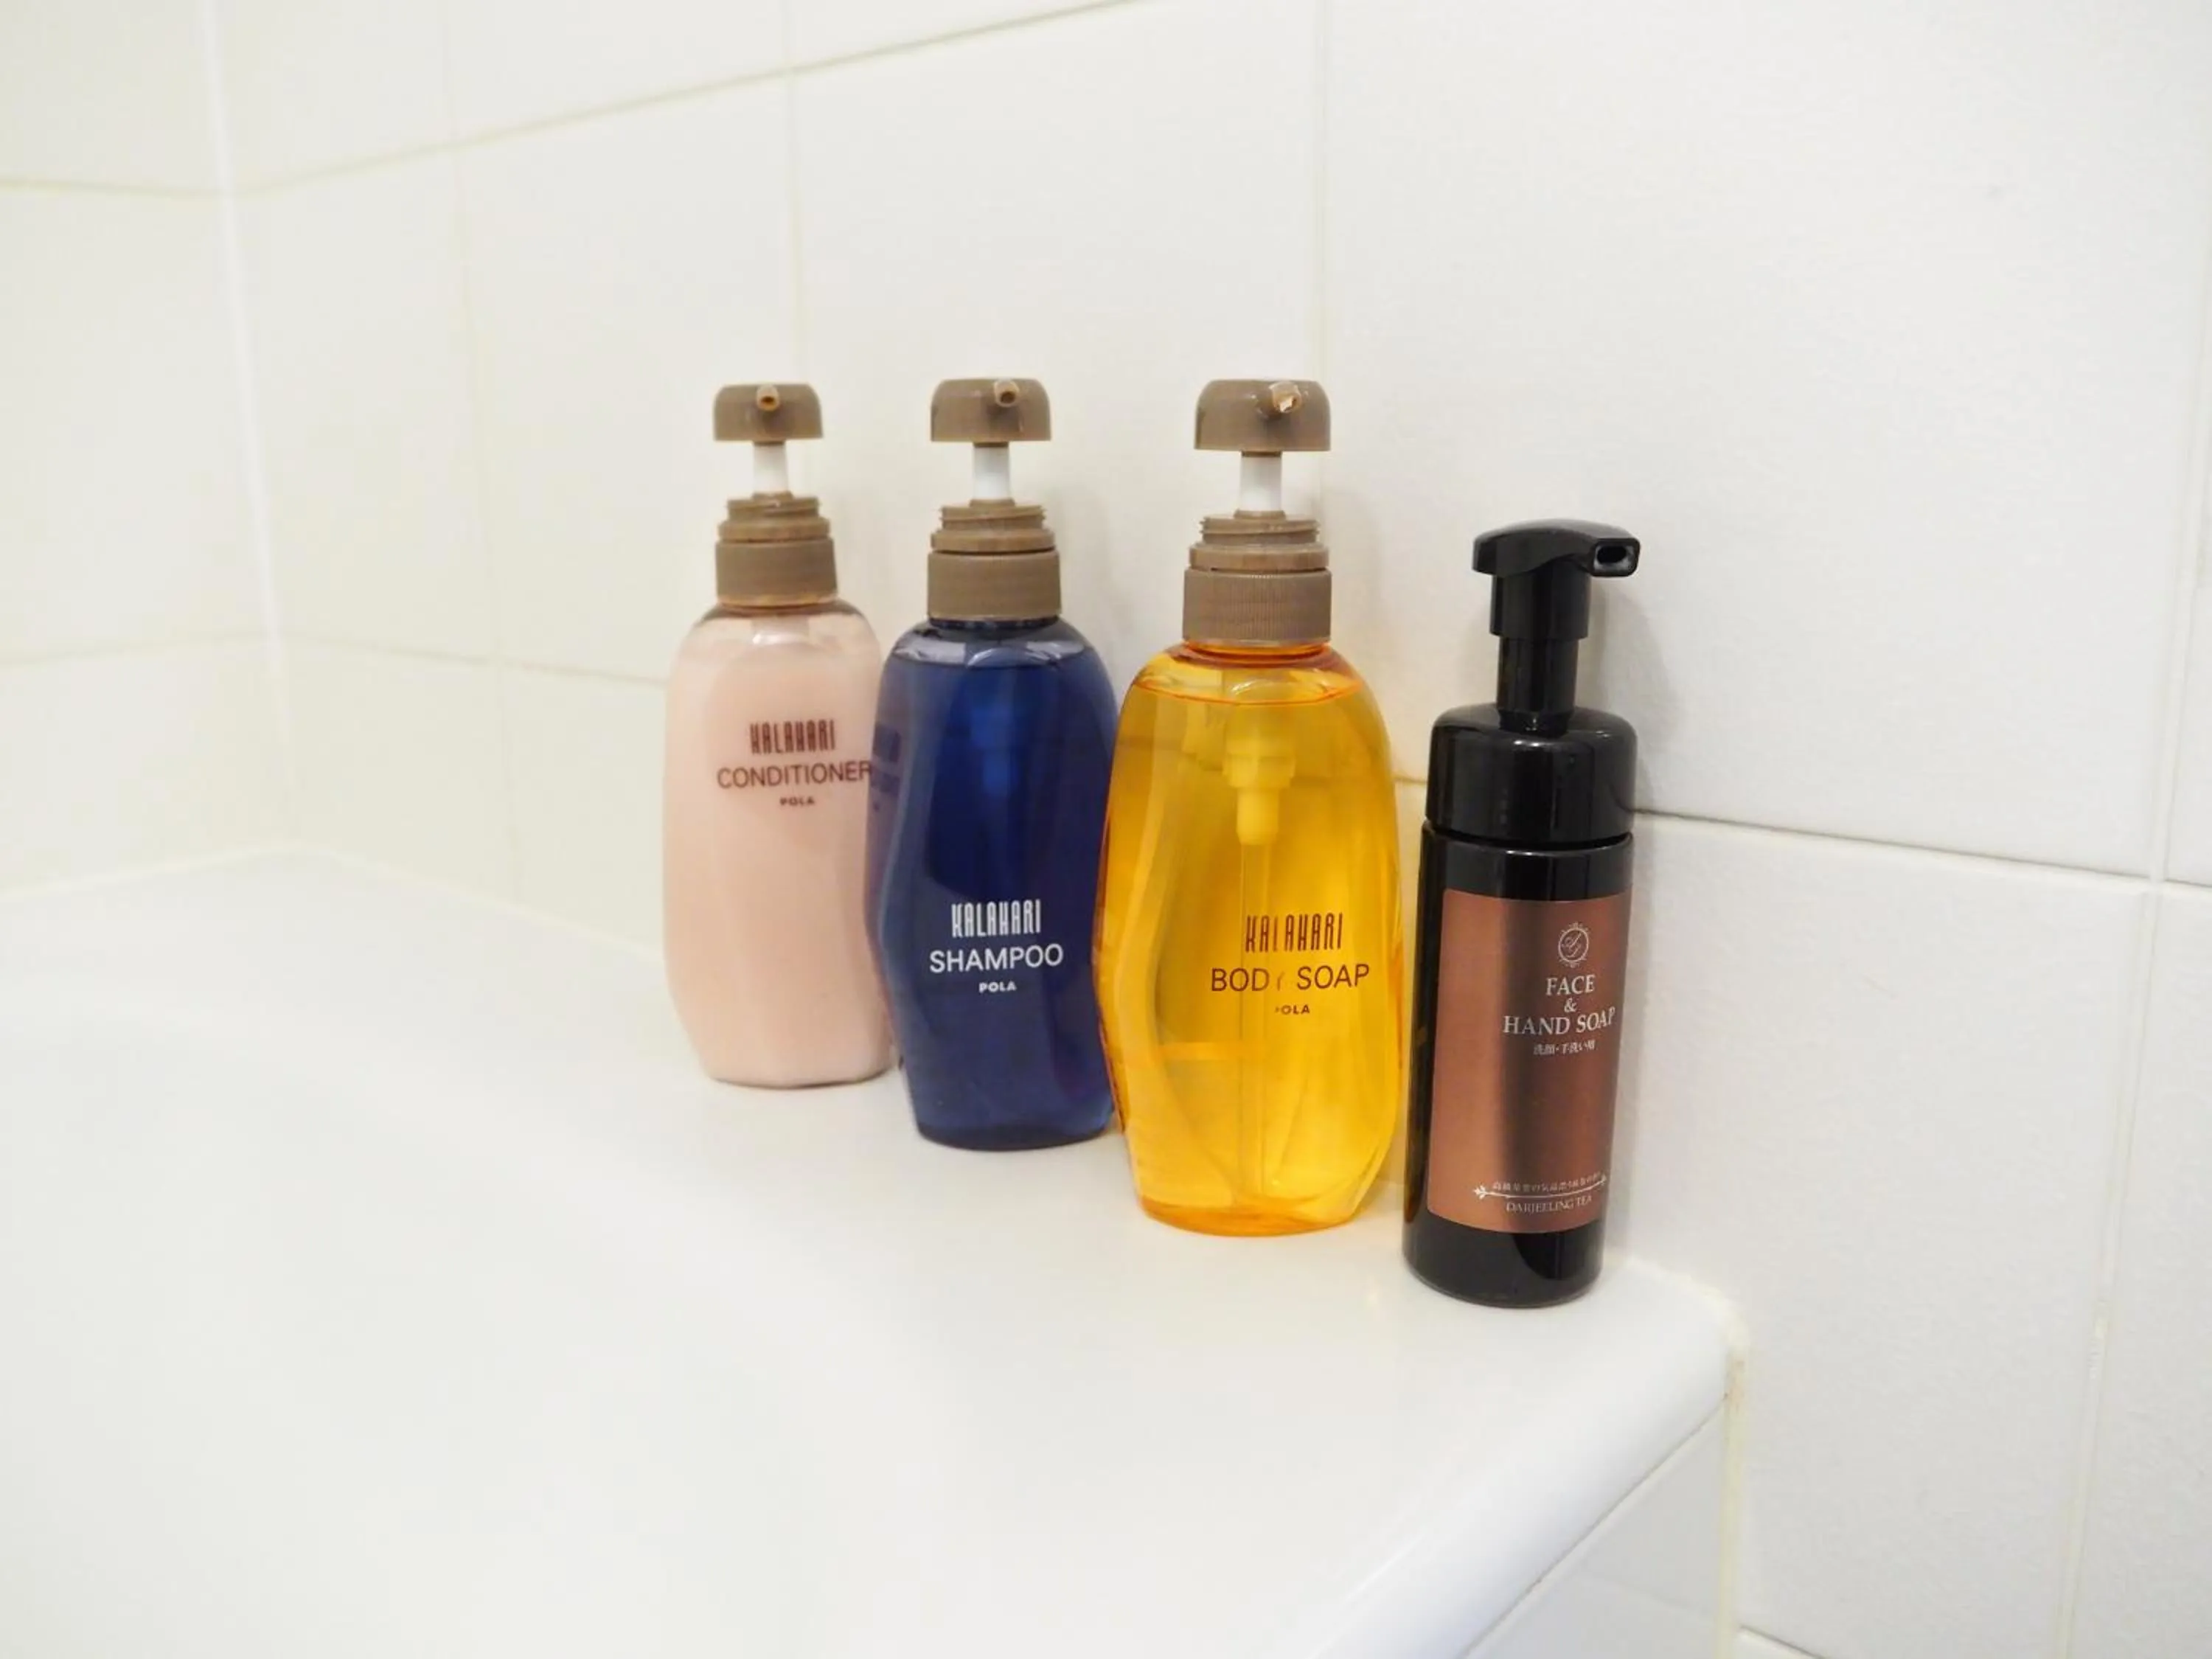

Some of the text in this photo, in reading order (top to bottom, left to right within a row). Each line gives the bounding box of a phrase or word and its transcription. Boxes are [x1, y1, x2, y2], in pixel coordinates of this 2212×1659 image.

[749, 719, 836, 755] KALAHARI
[716, 760, 872, 789] CONDITIONER
[779, 796, 815, 807] POLA
[951, 898, 1042, 939] KALAHARI
[929, 943, 1064, 973] SHAMPOO
[978, 981, 1018, 993] POLA
[1296, 963, 1370, 991] SOAP
[1545, 974, 1596, 995] FACE
[1275, 1004, 1311, 1016] OLA
[1564, 998, 1577, 1013] &
[1503, 1006, 1616, 1036] HAND SOAP
